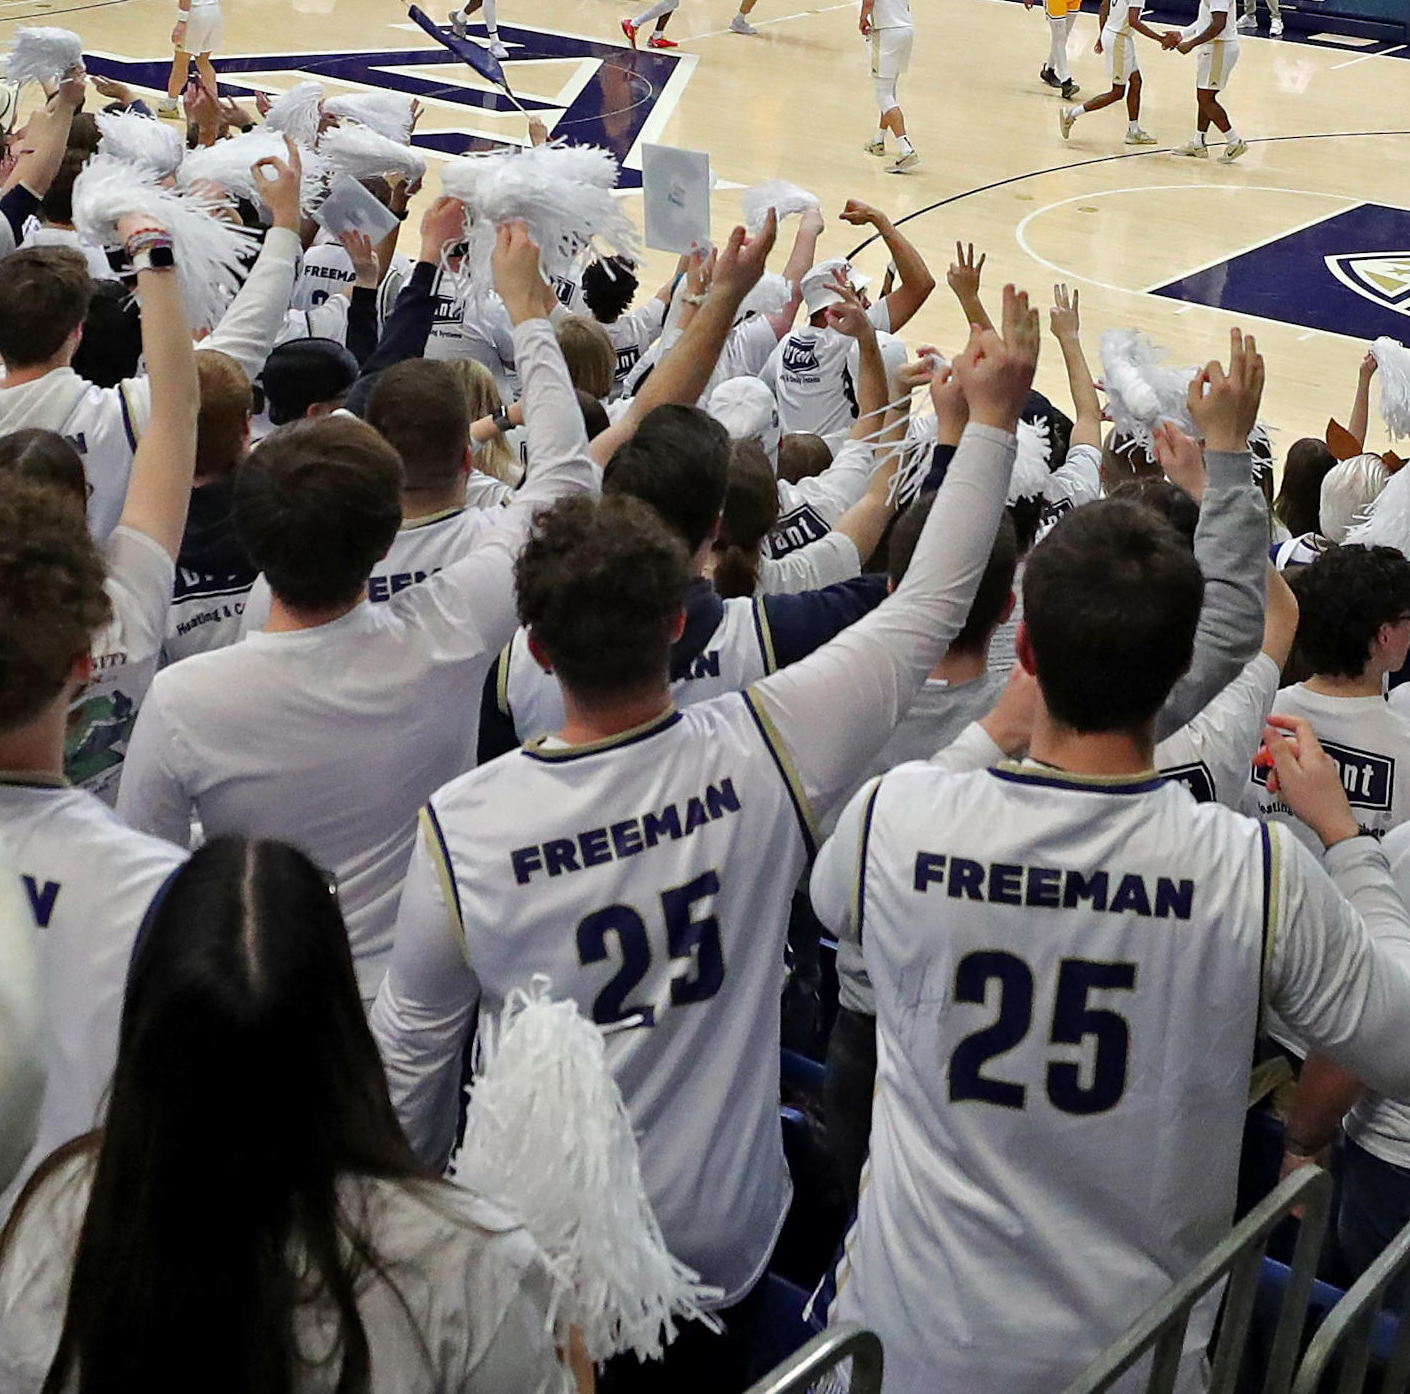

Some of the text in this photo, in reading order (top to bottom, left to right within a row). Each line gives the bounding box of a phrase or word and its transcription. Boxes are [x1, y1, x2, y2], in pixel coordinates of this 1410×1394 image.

[177, 608, 221, 635] Heating
[510, 776, 742, 887] FREEMAN
[912, 849, 1196, 922] FREEMAN
[575, 869, 728, 1029] 25
[946, 948, 1139, 1116] 25
